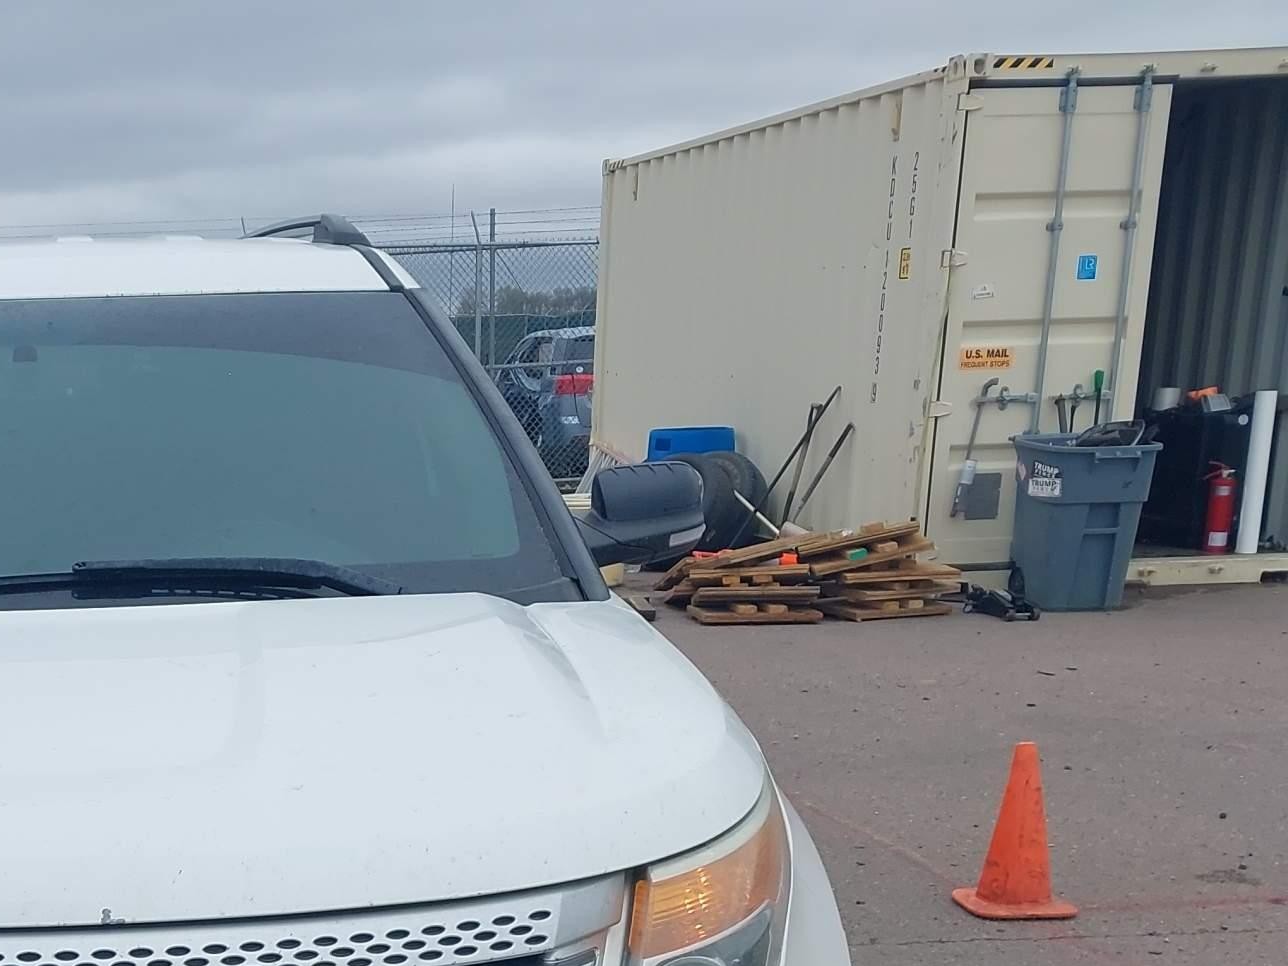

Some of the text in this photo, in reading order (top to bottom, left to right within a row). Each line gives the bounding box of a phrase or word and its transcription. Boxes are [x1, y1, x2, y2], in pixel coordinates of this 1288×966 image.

[965, 348, 1010, 360] U.S. MAIL
[989, 360, 1010, 368] STOPS
